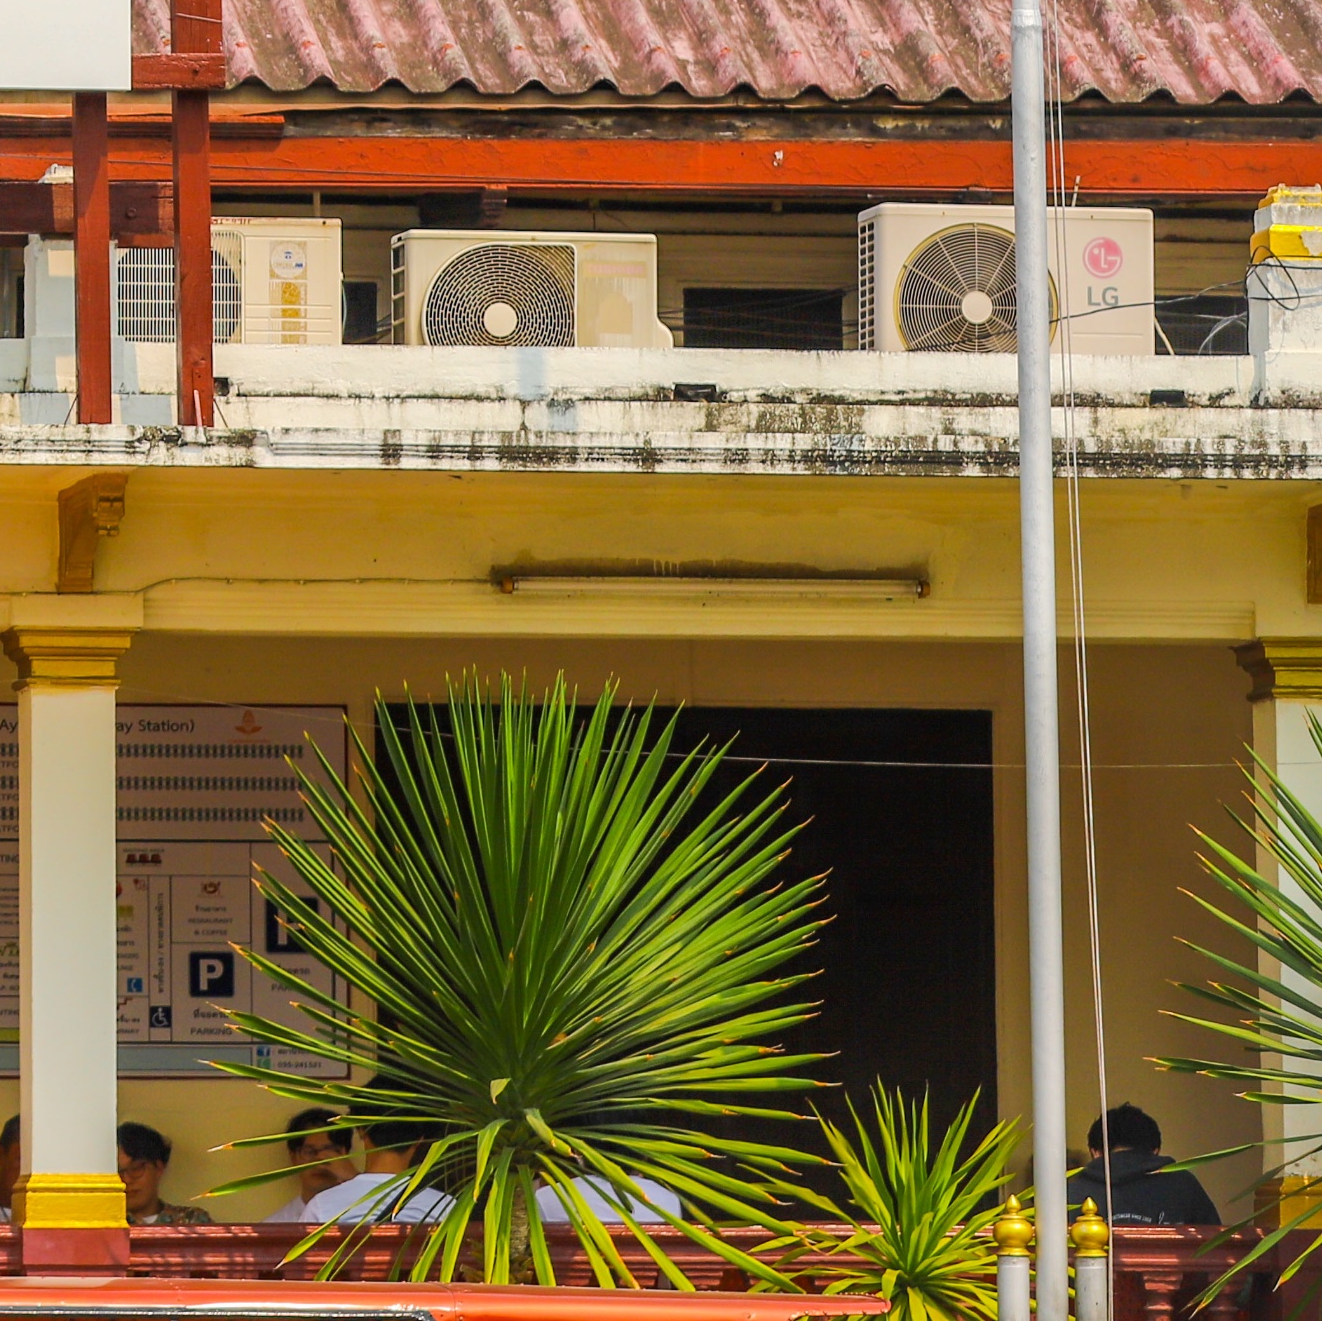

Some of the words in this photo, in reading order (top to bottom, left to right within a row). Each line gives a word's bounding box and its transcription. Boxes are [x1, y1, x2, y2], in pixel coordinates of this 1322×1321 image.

[1087, 285, 1120, 308] LG
[138, 719, 195, 733] Station)
[199, 959, 224, 991] P
